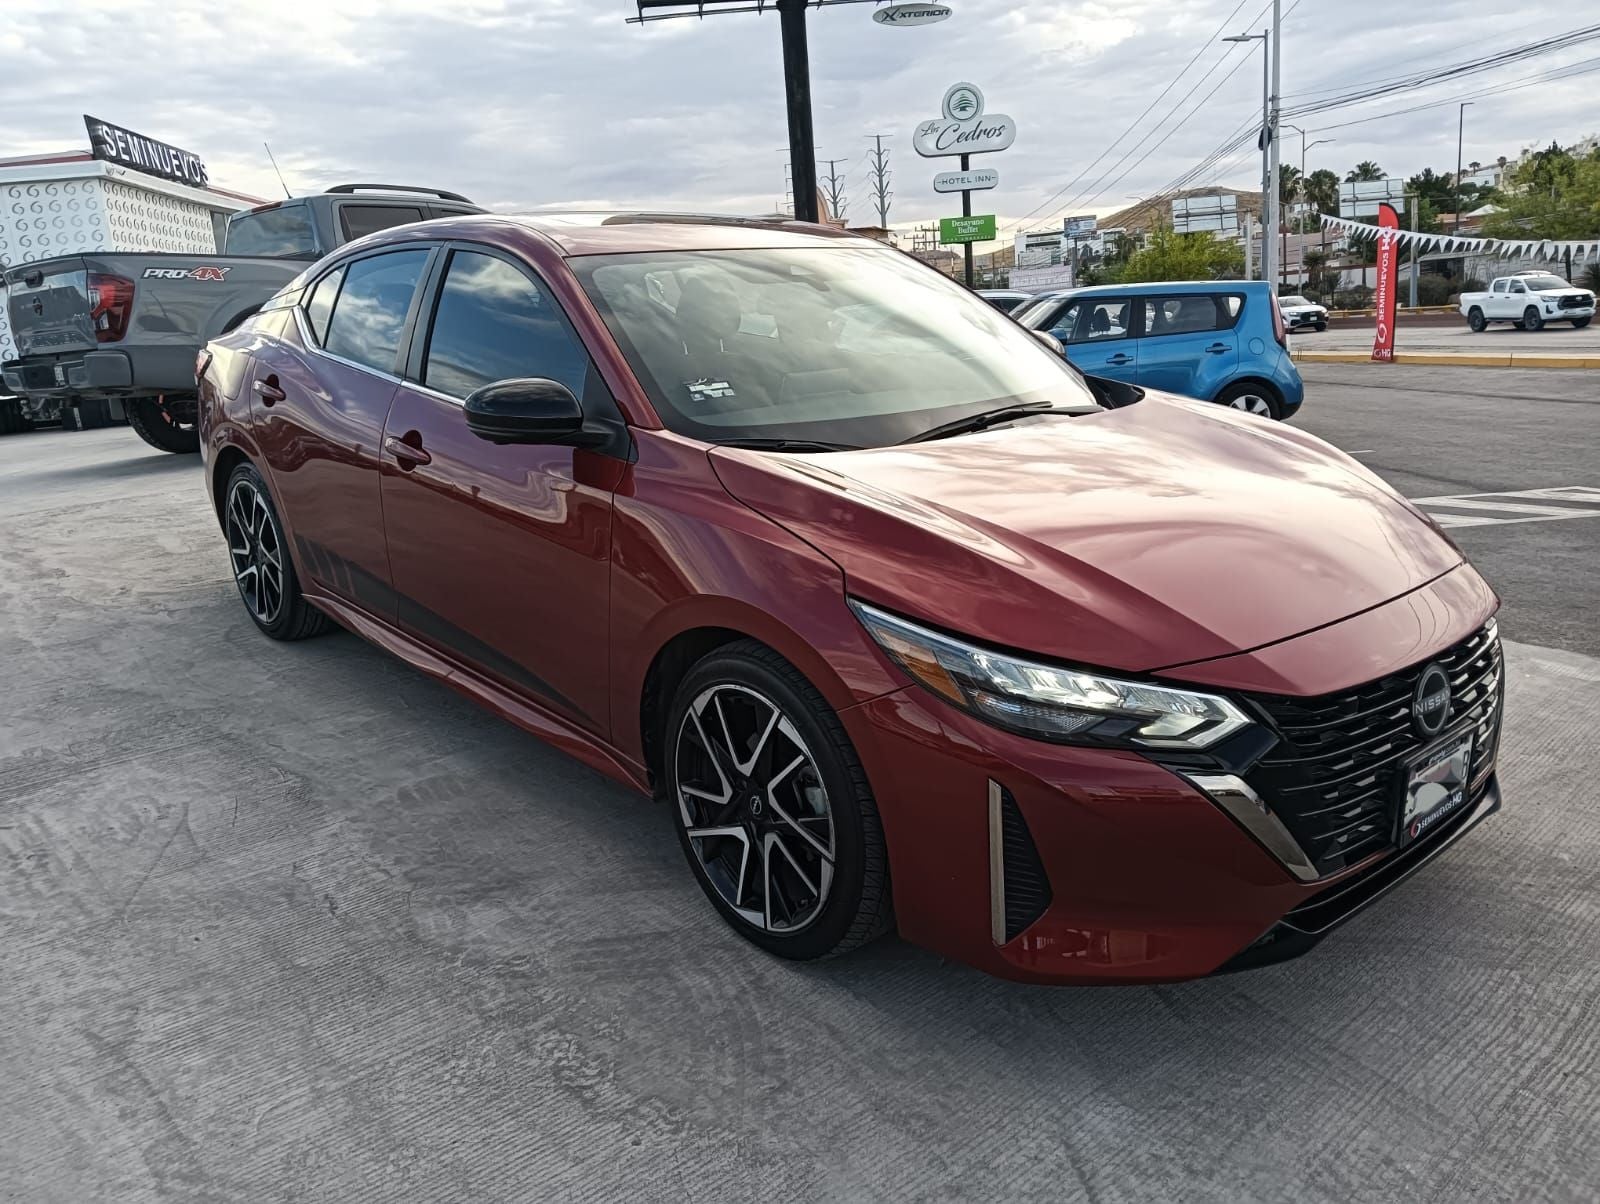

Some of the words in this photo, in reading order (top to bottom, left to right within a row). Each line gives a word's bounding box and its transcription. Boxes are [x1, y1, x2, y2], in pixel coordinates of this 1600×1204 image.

[936, 120, 1007, 150] Cedros
[102, 124, 209, 187] SEMINUEVOS
[951, 219, 985, 228] Desayuno
[958, 226, 979, 234] Buffet
[142, 267, 232, 281] PRO-4X
[1378, 252, 1389, 321] SEMINUEVOS
[1414, 688, 1451, 715] NISSAN
